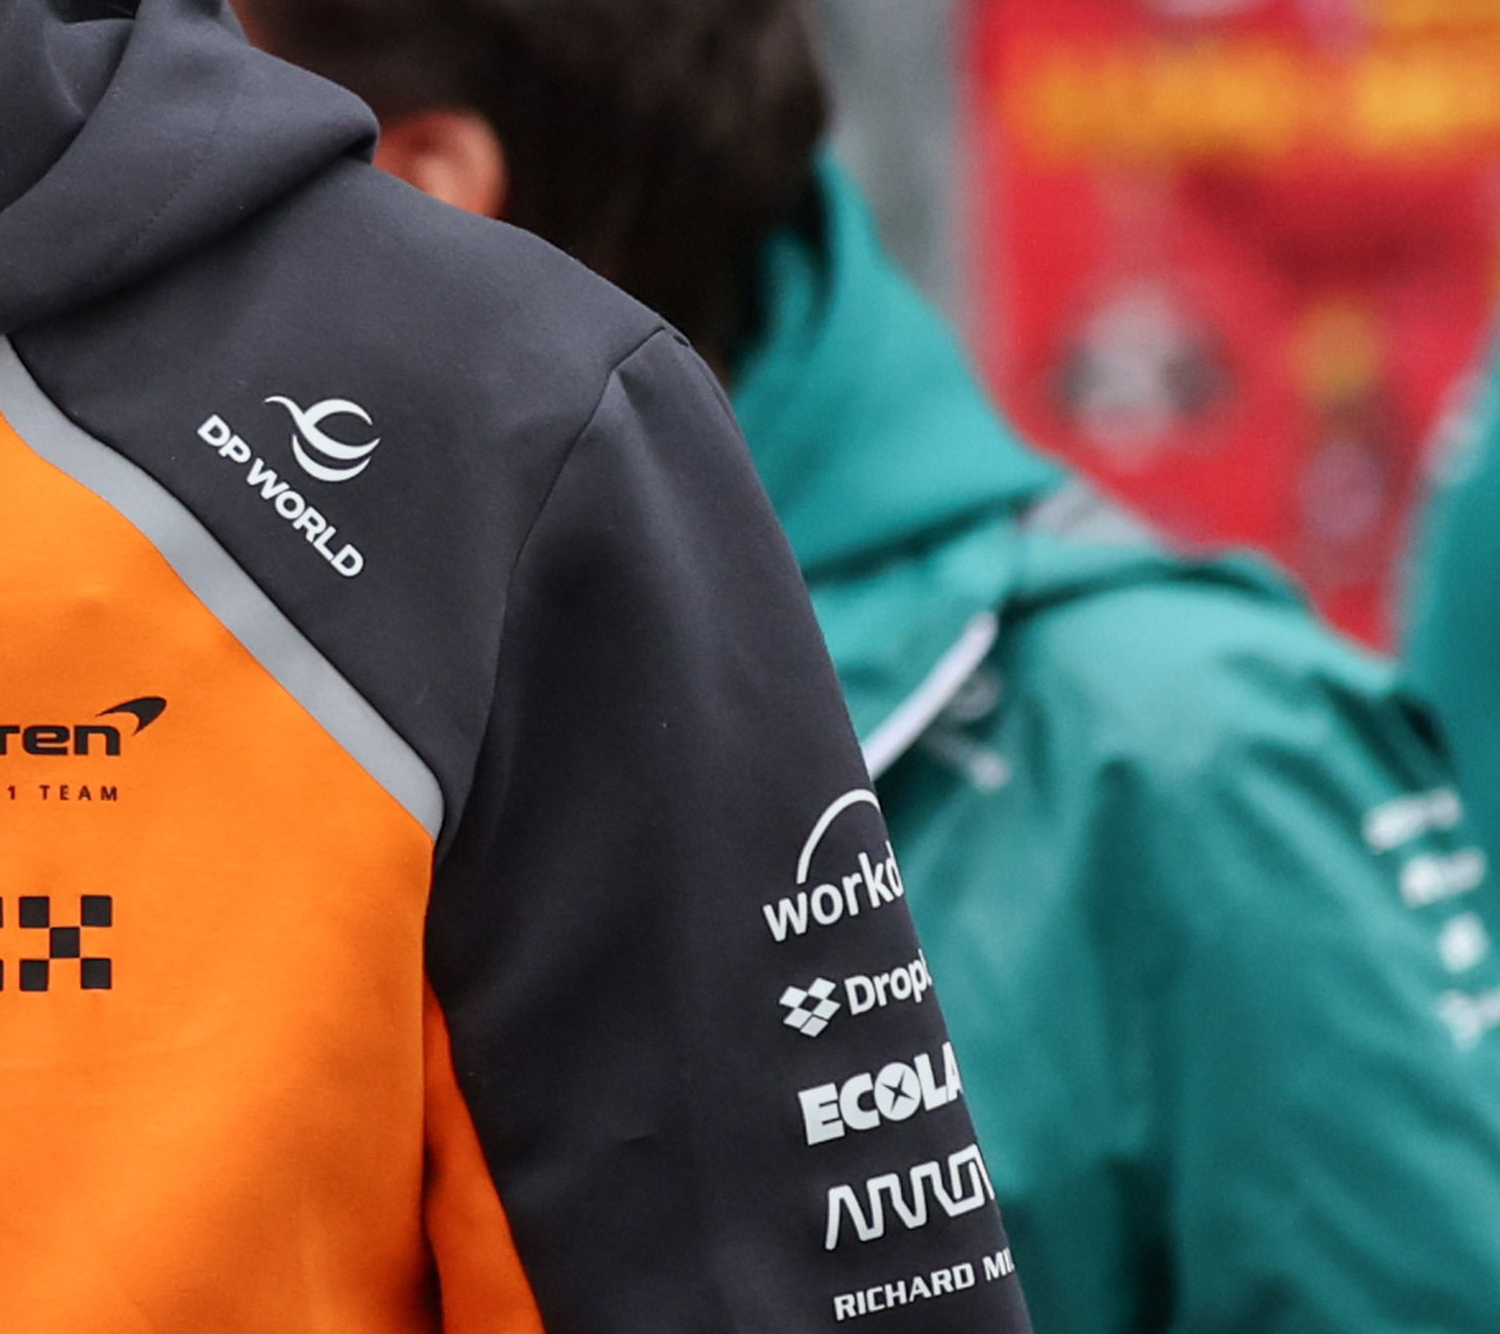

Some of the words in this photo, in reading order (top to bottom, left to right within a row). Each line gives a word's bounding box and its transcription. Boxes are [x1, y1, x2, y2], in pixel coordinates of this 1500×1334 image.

[196, 413, 252, 464] DP
[245, 457, 365, 578] WORLD
[7, 784, 19, 801] 1
[40, 784, 119, 802] TEAM
[833, 1262, 976, 1321] RICHARD
